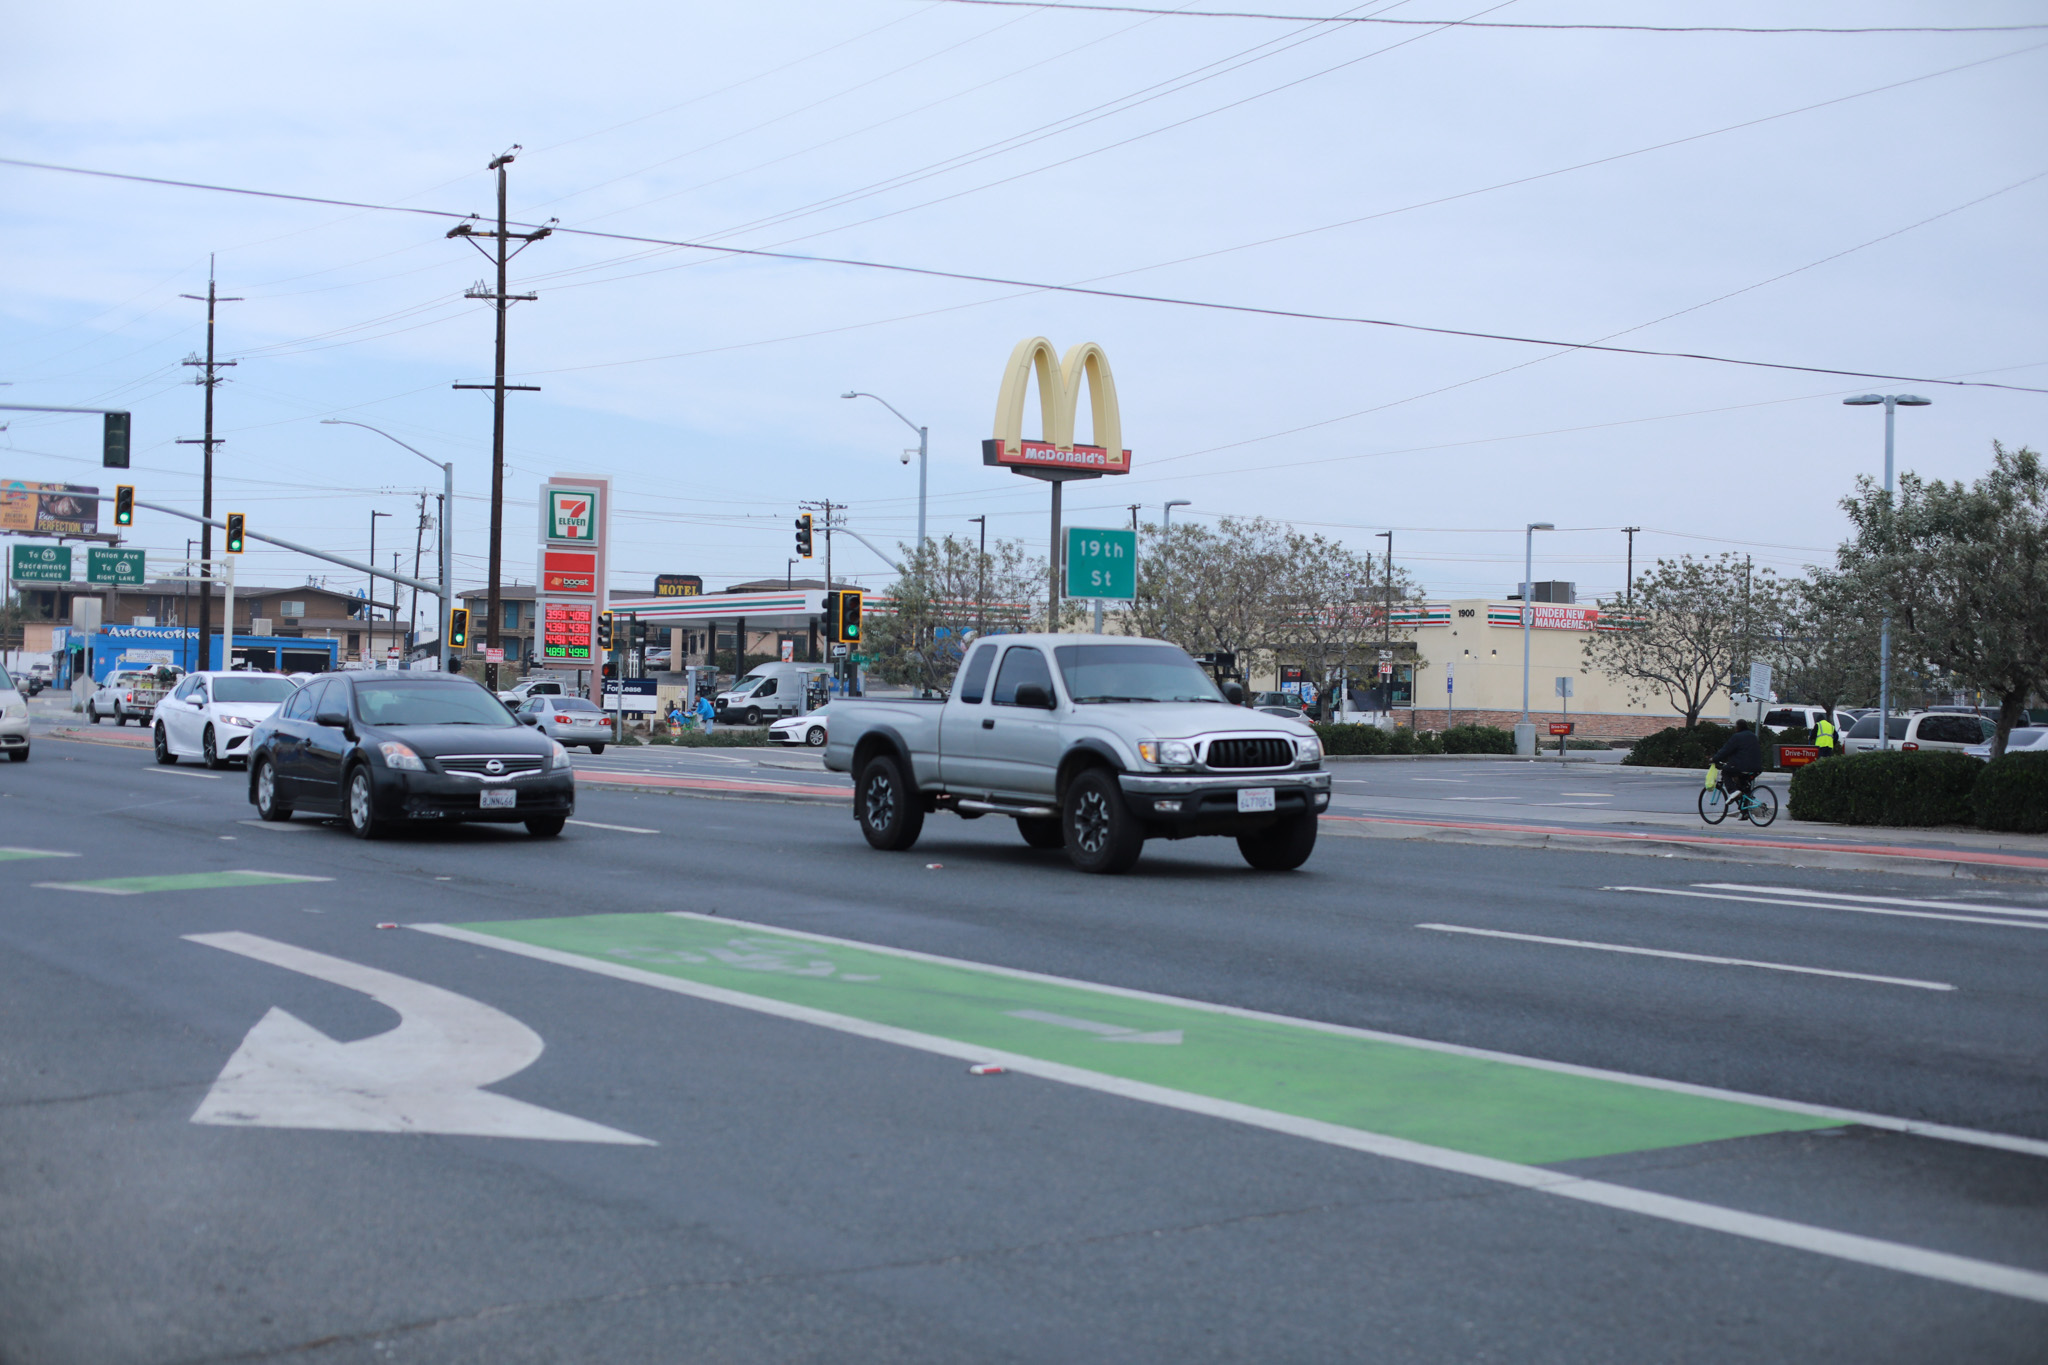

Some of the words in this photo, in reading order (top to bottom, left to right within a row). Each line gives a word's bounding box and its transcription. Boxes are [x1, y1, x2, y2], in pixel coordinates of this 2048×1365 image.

[1025, 448, 1105, 464] McDonald's
[560, 499, 586, 537] 7
[1080, 540, 1123, 558] 19th
[95, 551, 118, 559] Union
[18, 562, 66, 571] Sacramento
[563, 577, 589, 586] boost
[1091, 570, 1112, 587] St
[658, 584, 699, 596] MOTEL
[1458, 609, 1475, 617] 1900
[1536, 608, 1565, 619] UNDER
[1566, 609, 1585, 619] NEW
[621, 684, 642, 693] Lease
